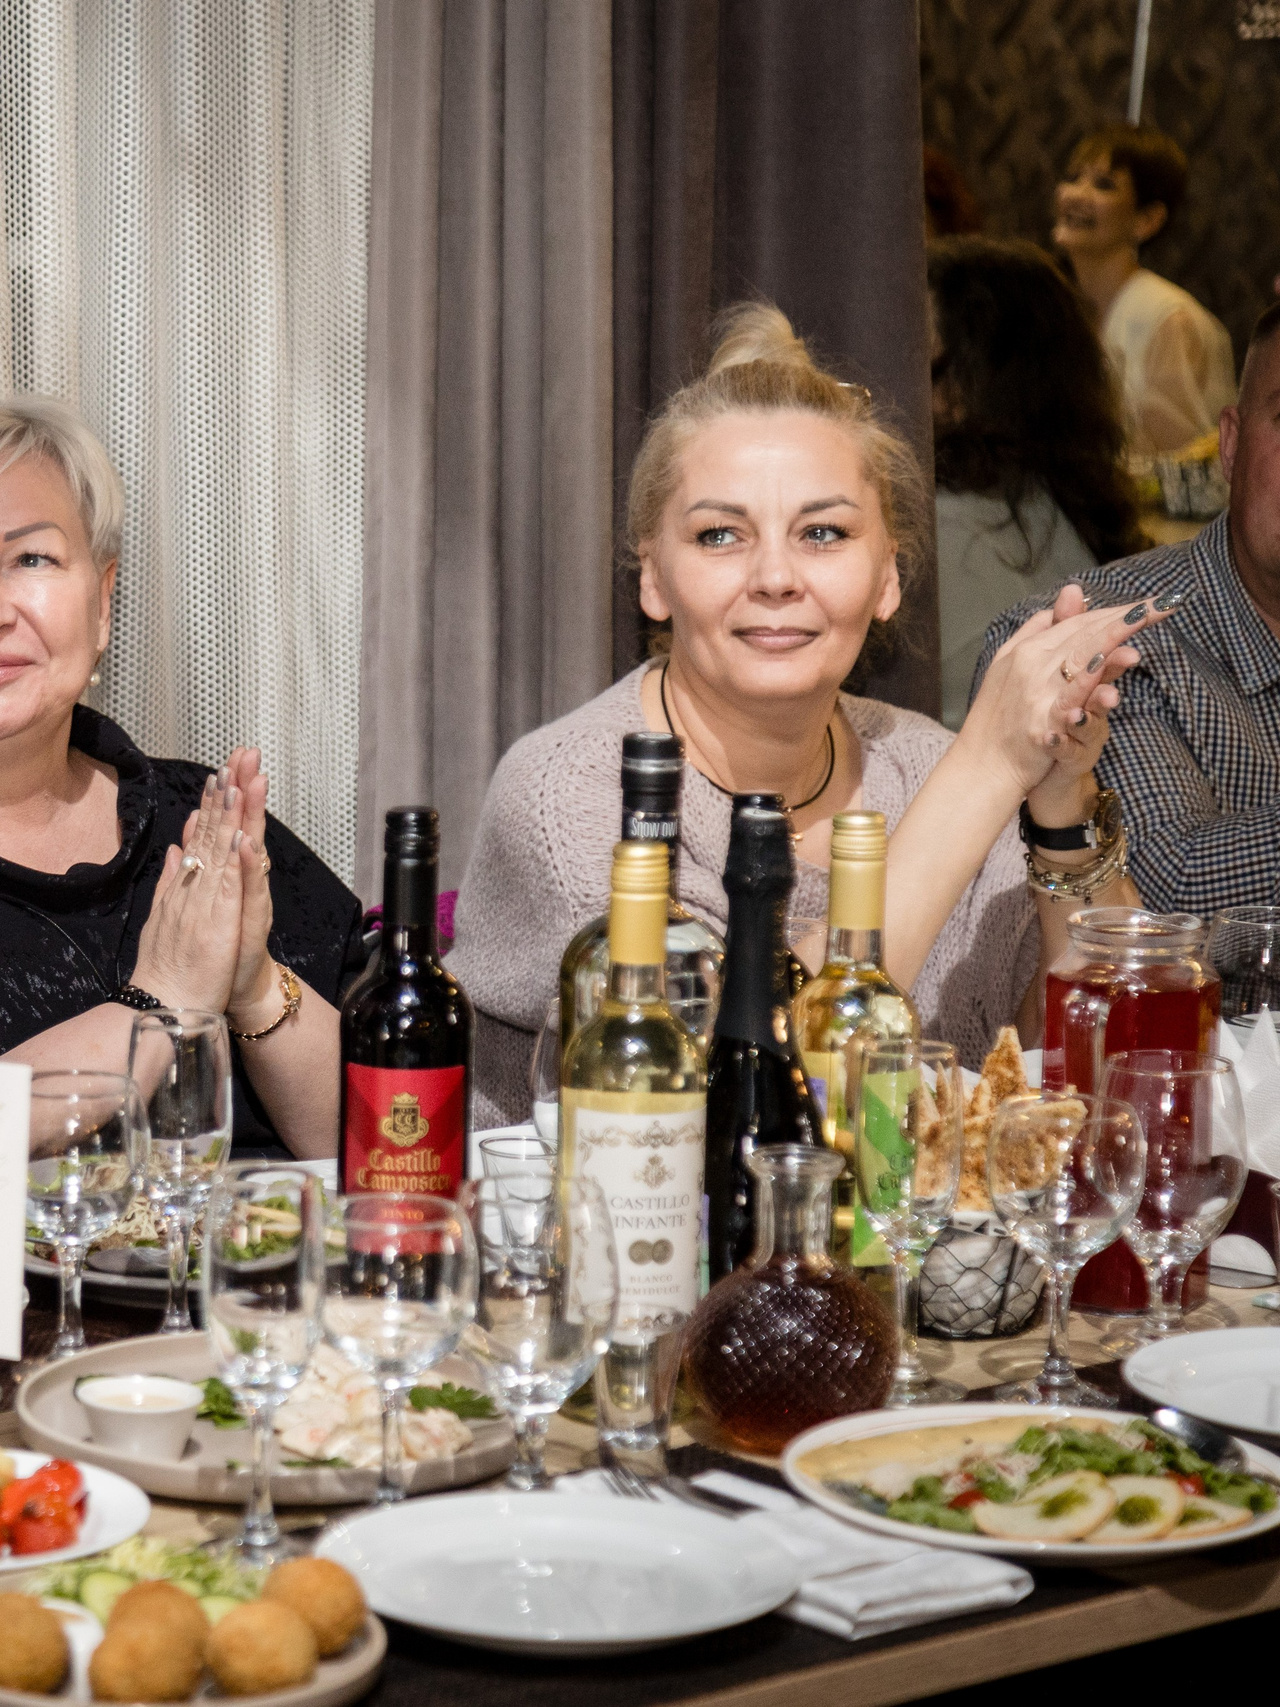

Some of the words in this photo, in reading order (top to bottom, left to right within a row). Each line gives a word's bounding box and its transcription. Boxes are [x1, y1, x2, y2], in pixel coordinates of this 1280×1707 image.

[631, 817, 660, 837] Snow
[369, 1148, 441, 1172] Castillo
[610, 1194, 690, 1210] CASTILLO
[381, 1208, 424, 1221] TINTO
[614, 1212, 686, 1230] INFANTE
[630, 1273, 674, 1284] BLANCO
